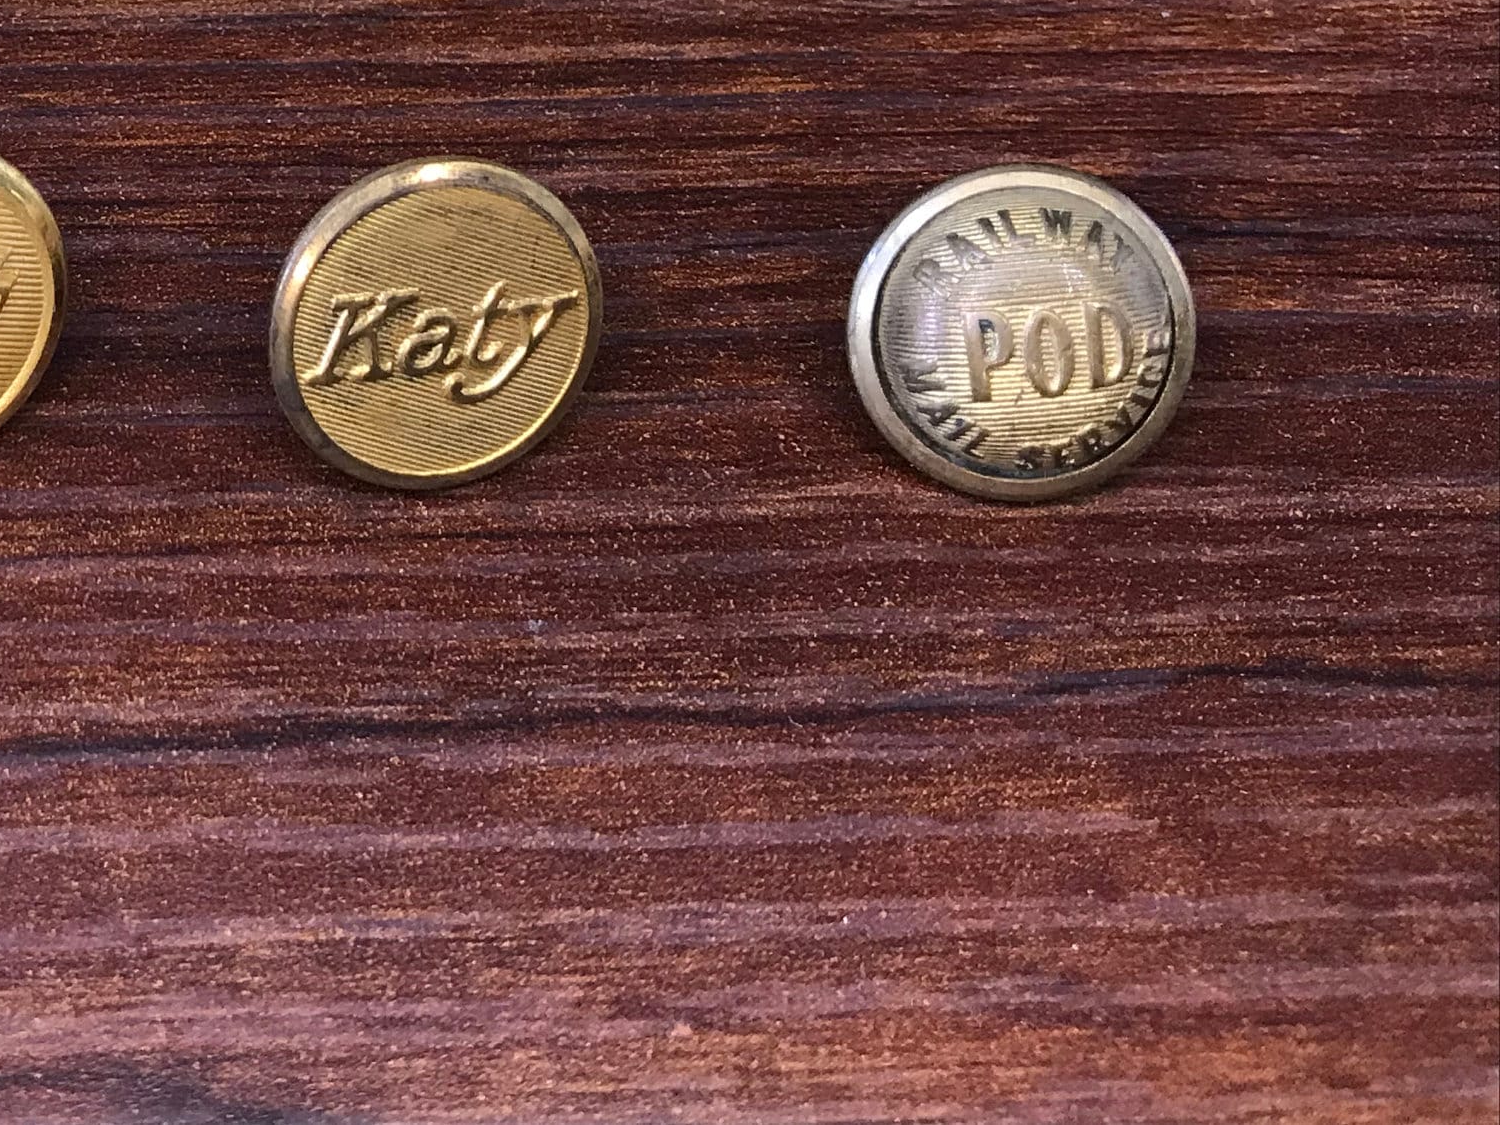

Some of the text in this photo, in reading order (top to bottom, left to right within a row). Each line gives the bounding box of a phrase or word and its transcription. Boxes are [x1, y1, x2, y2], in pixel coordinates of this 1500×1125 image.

[301, 279, 580, 405] Katy
[896, 328, 1172, 469] MAIL SERVICE
[960, 301, 1134, 402] POD
